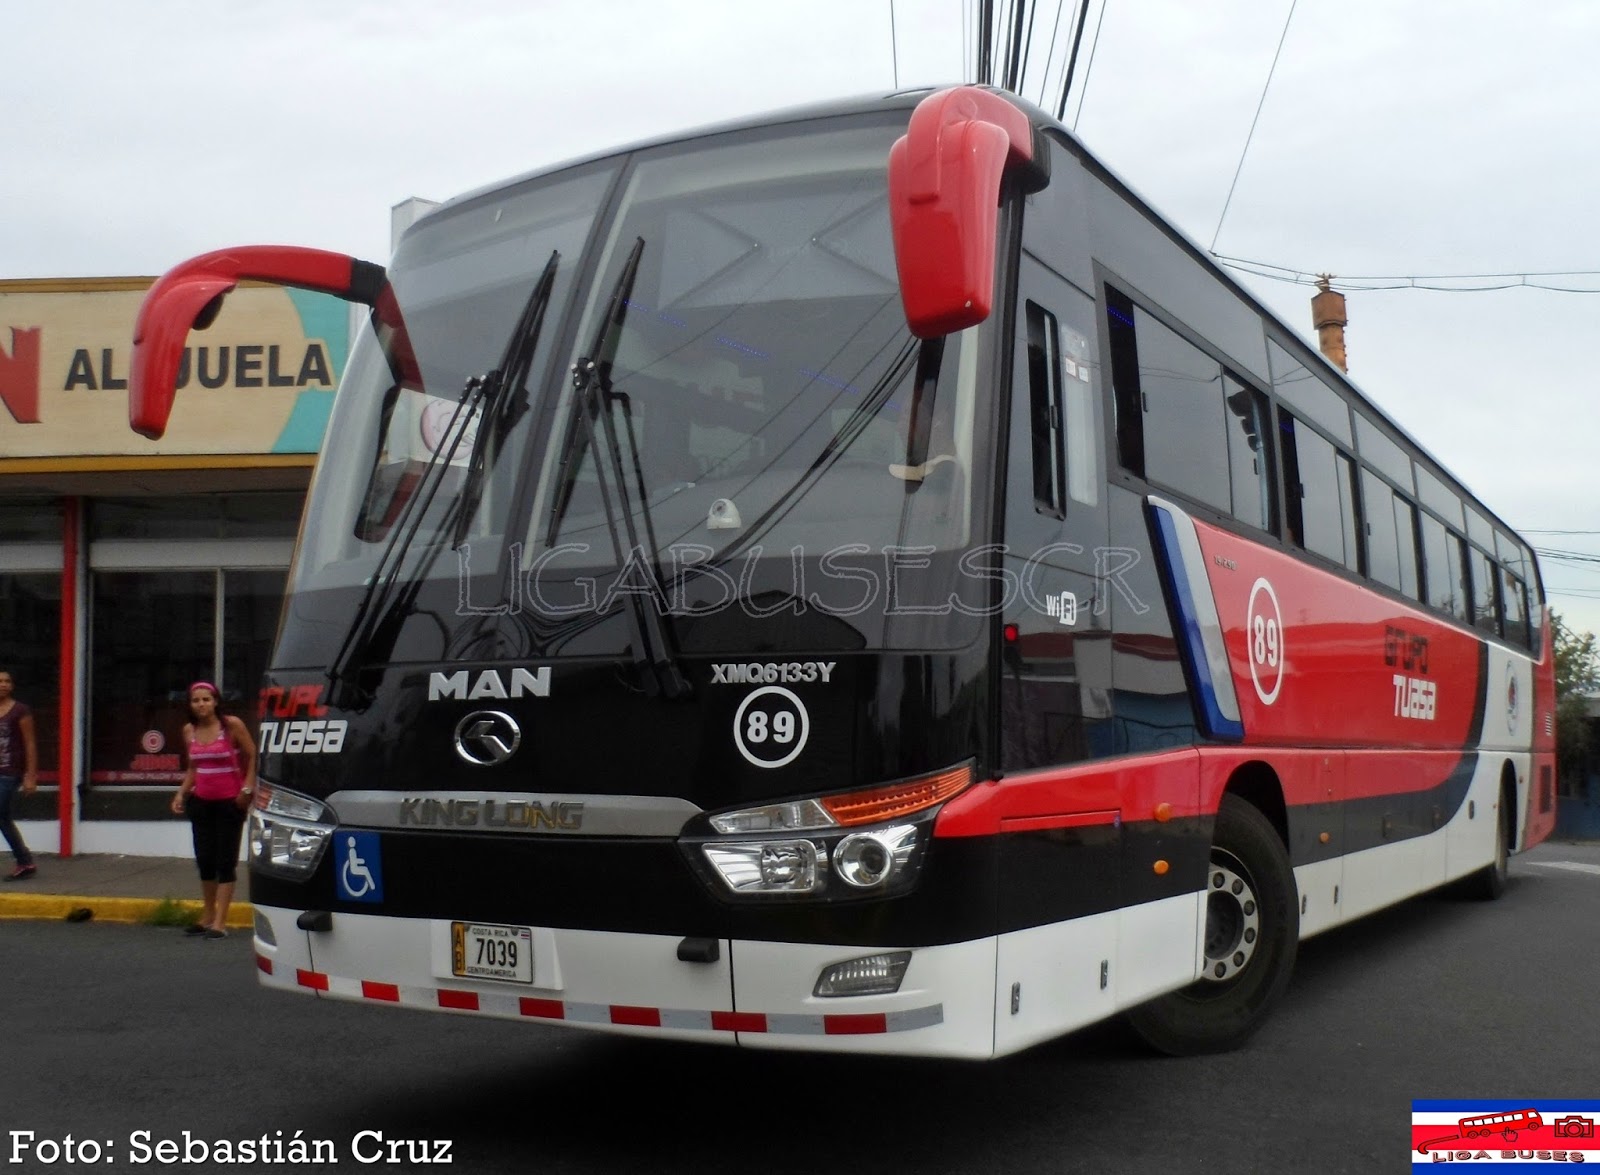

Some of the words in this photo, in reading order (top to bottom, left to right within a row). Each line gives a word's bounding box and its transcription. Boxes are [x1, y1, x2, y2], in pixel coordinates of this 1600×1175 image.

[64, 343, 332, 392] ALJUELA
[1253, 615, 1278, 667] 89
[429, 667, 551, 701] MAN
[710, 661, 837, 685] XMQ6133Y
[746, 711, 796, 744] 89
[399, 797, 480, 826] KING
[484, 799, 584, 830] LONG
[476, 938, 518, 968] 7039
